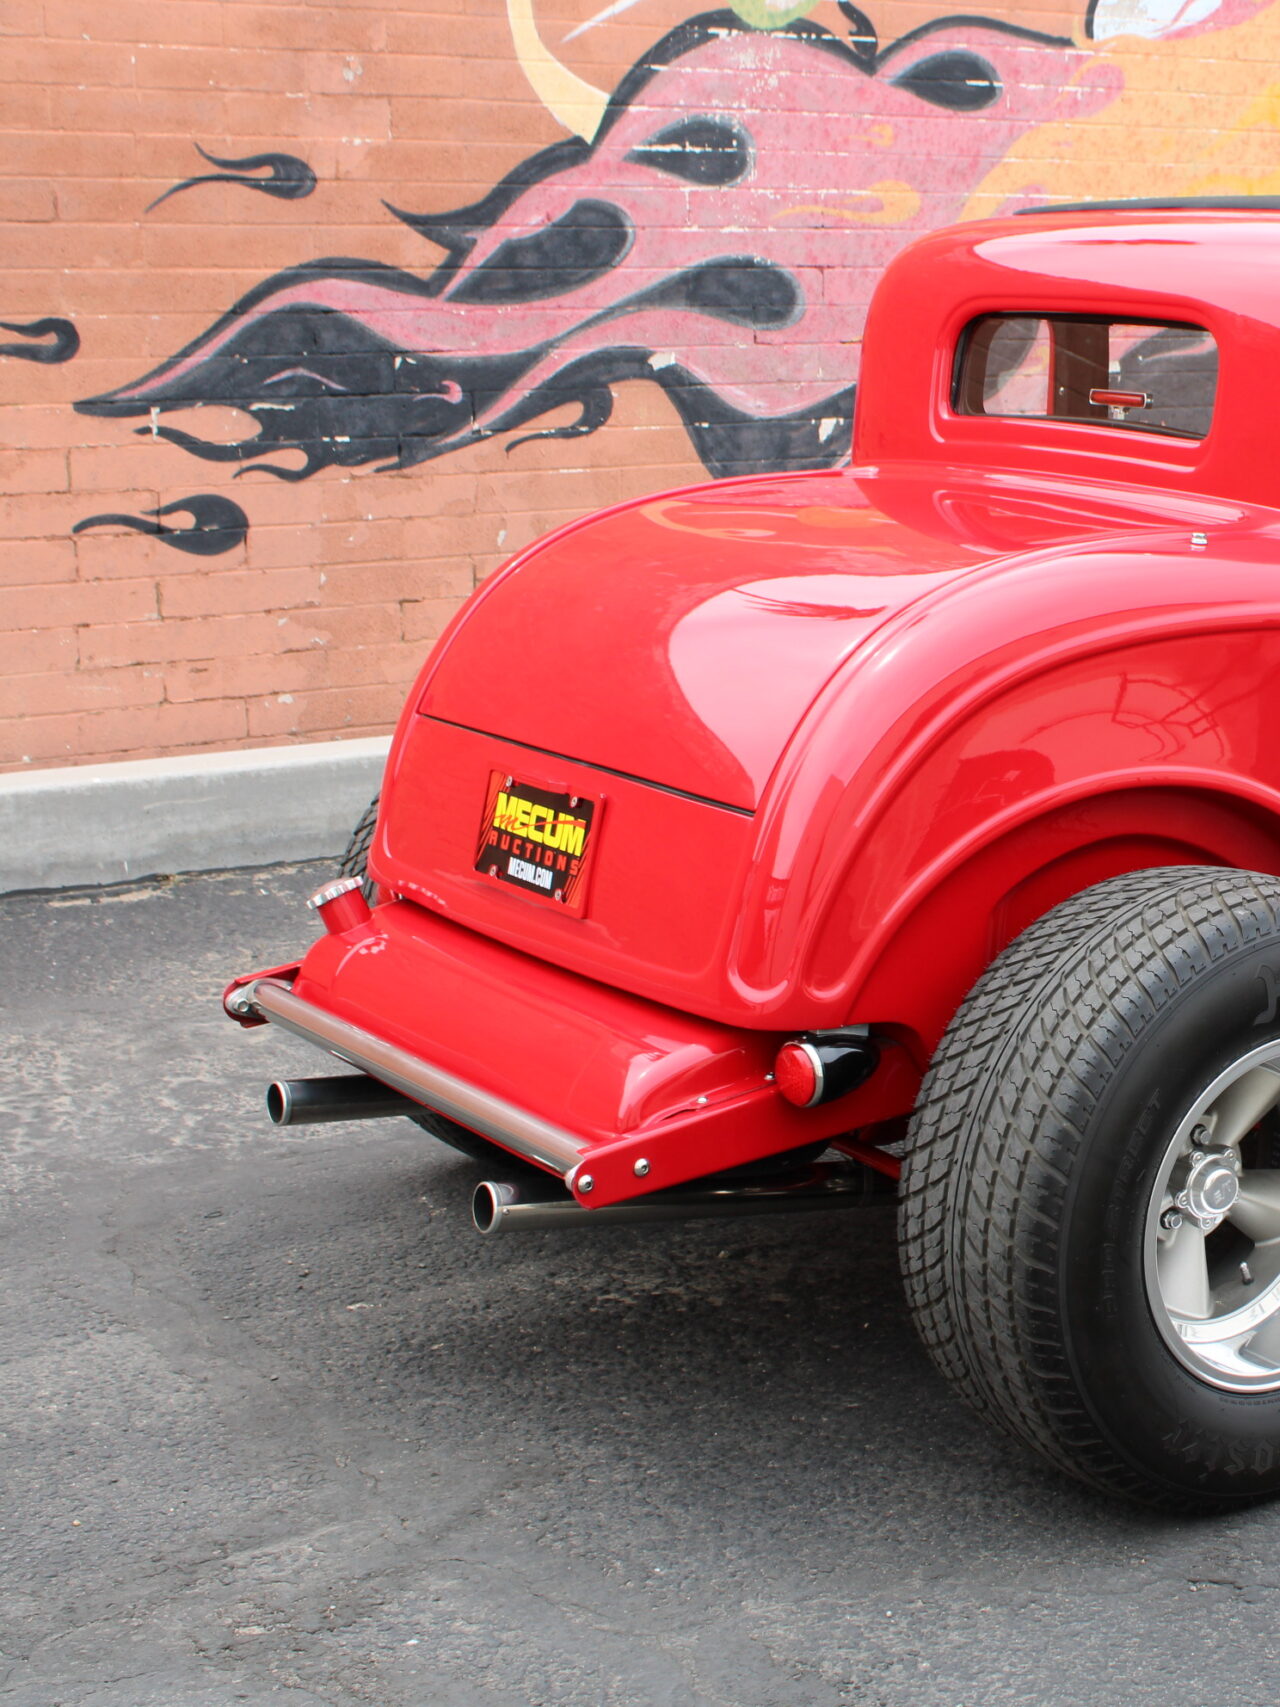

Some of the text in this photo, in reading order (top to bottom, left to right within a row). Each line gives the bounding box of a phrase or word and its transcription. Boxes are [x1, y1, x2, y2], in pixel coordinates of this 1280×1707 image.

[493, 791, 586, 857] MECUM
[488, 829, 581, 877] AUCTIONS
[507, 856, 553, 890] MECUM.COM
